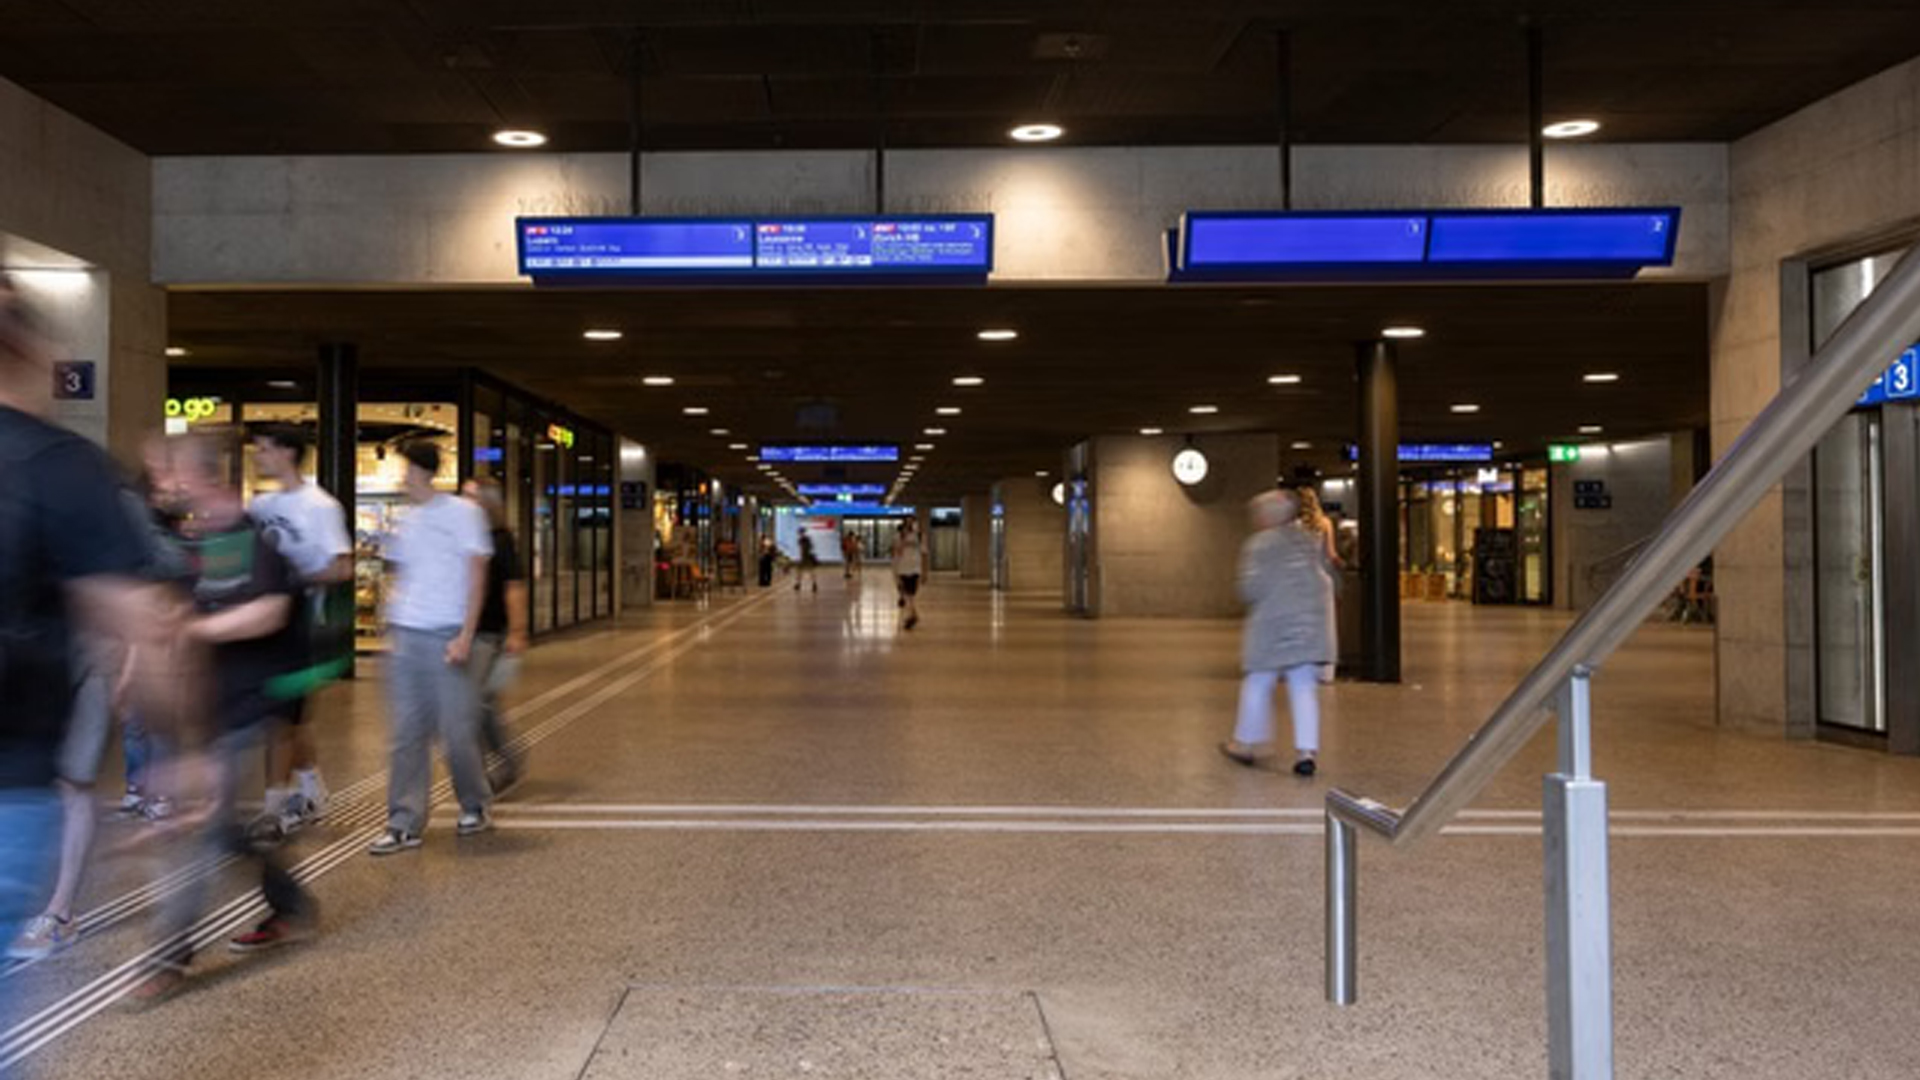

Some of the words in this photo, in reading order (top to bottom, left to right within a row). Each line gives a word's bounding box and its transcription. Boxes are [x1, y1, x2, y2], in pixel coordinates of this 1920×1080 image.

[65, 372, 81, 392] 3
[1893, 363, 1909, 391] 3
[183, 398, 215, 421] go
